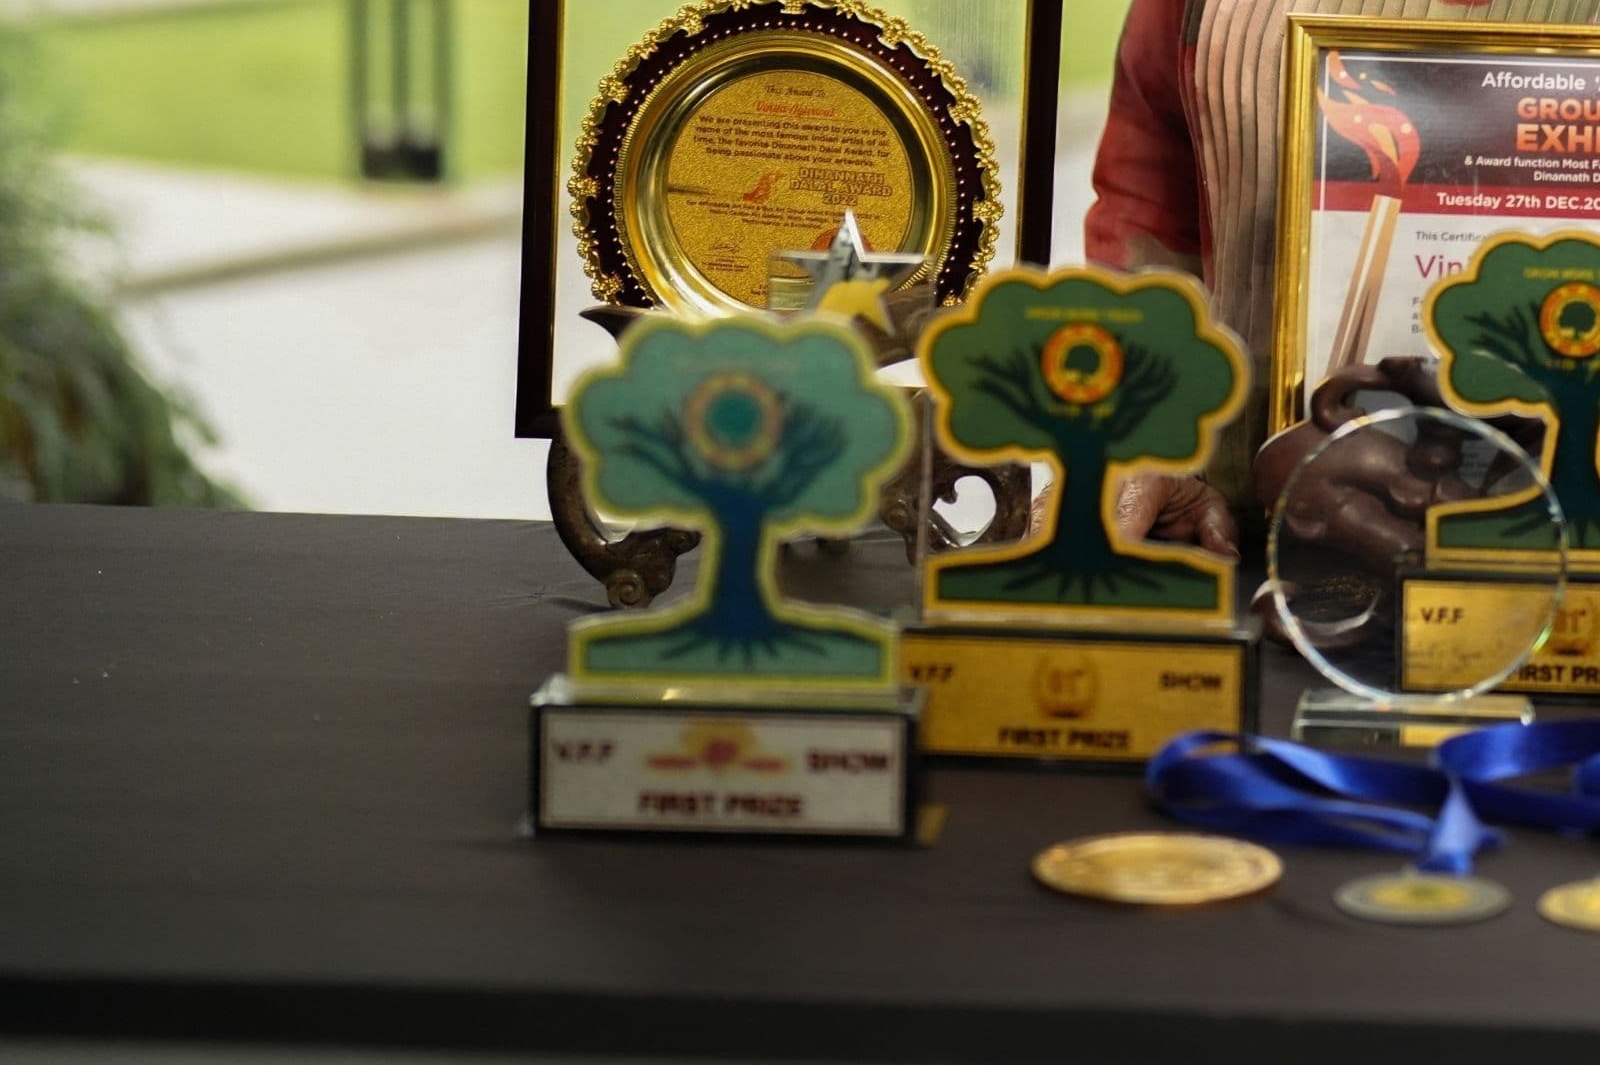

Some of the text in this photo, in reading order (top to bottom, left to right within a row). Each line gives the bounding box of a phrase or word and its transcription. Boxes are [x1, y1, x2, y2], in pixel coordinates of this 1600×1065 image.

[1481, 72, 1586, 91] Affordable
[700, 115, 714, 124] We
[733, 118, 780, 129] presenting
[783, 121, 799, 130] this
[801, 123, 828, 132] award
[831, 125, 841, 133] to
[841, 127, 860, 136] you
[871, 128, 887, 137] the
[696, 126, 721, 135] name
[723, 127, 733, 135] of
[734, 128, 749, 136] the
[752, 130, 774, 138] most
[776, 131, 808, 141] famous
[811, 134, 838, 143] Indian
[841, 136, 864, 146] artist
[866, 138, 877, 146] of
[718, 137, 733, 145] the
[706, 147, 732, 157] being
[734, 149, 782, 161] passionate
[784, 153, 810, 163] about
[812, 155, 833, 165] your
[1464, 156, 1473, 166] &
[1476, 157, 1511, 168] Award
[1513, 157, 1560, 169] function
[1562, 159, 1589, 170] Most
[1534, 171, 1590, 182] Dinannath
[822, 192, 858, 206] 2022
[839, 183, 893, 197] AWARD
[1436, 192, 1501, 210] Tuesday
[1505, 194, 1541, 209] 27th
[1415, 231, 1487, 243] This Certific
[1159, 671, 1222, 691] SHOW
[997, 727, 1131, 750] FIRST PRIZE
[806, 748, 889, 772] SHOW
[638, 790, 804, 817] FIRST PRIZE
